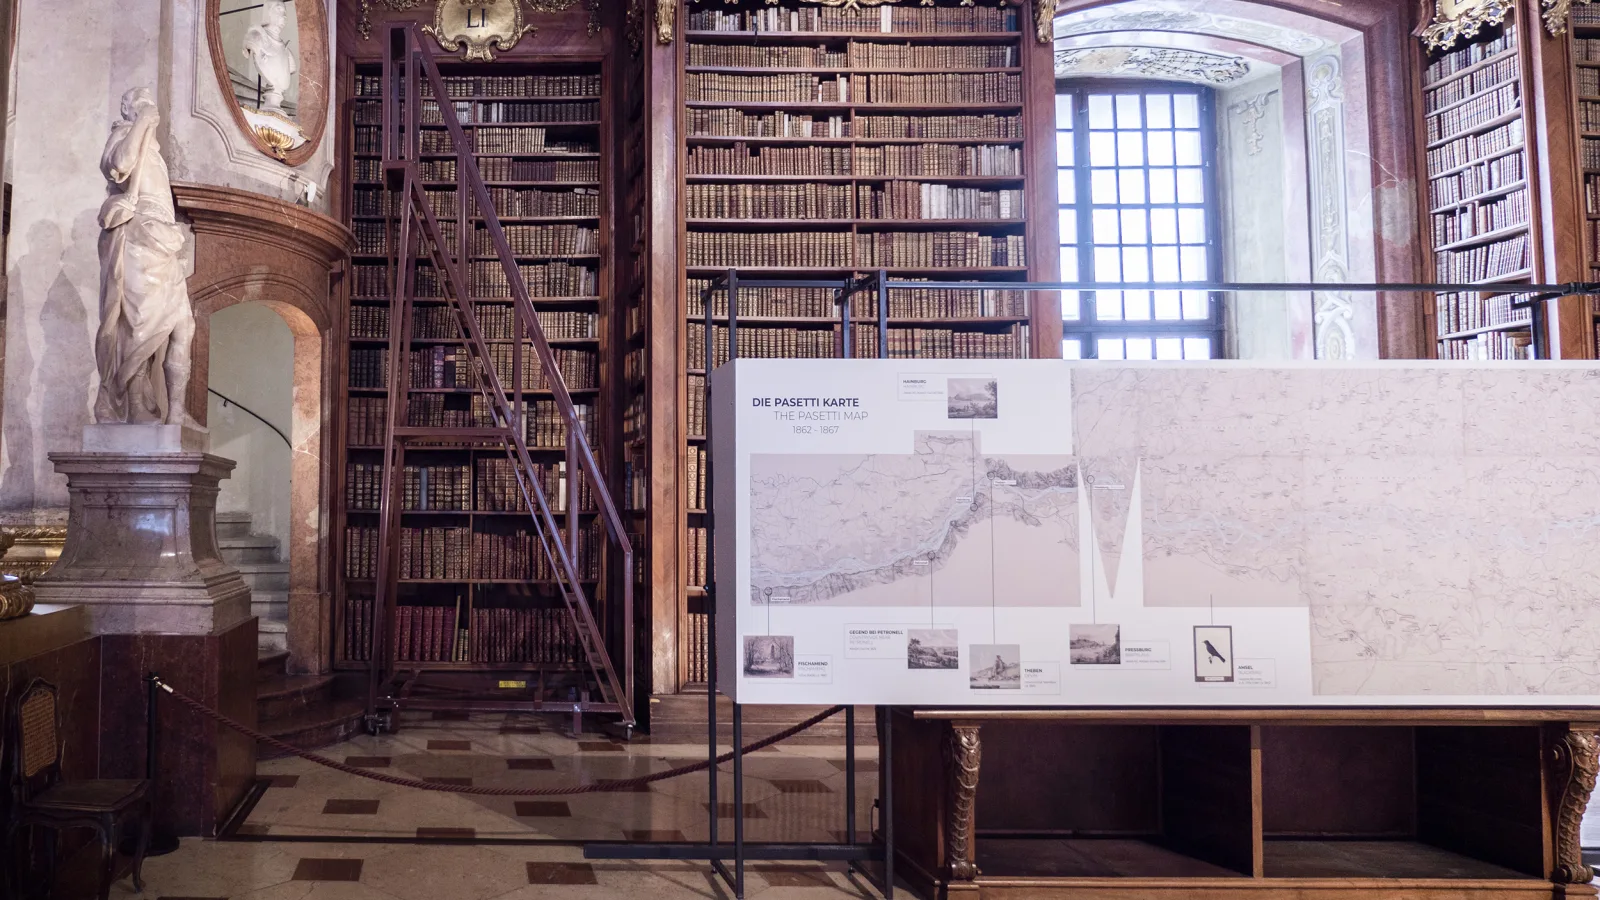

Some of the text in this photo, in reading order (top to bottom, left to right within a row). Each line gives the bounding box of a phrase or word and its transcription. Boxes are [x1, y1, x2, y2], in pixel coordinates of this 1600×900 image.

[467, 8, 486, 28] LI
[752, 397, 860, 407] DIE PASETTI KARTE
[773, 410, 869, 421] THE PASETTI MAP
[792, 425, 812, 434] 1862
[819, 425, 840, 434] 1867
